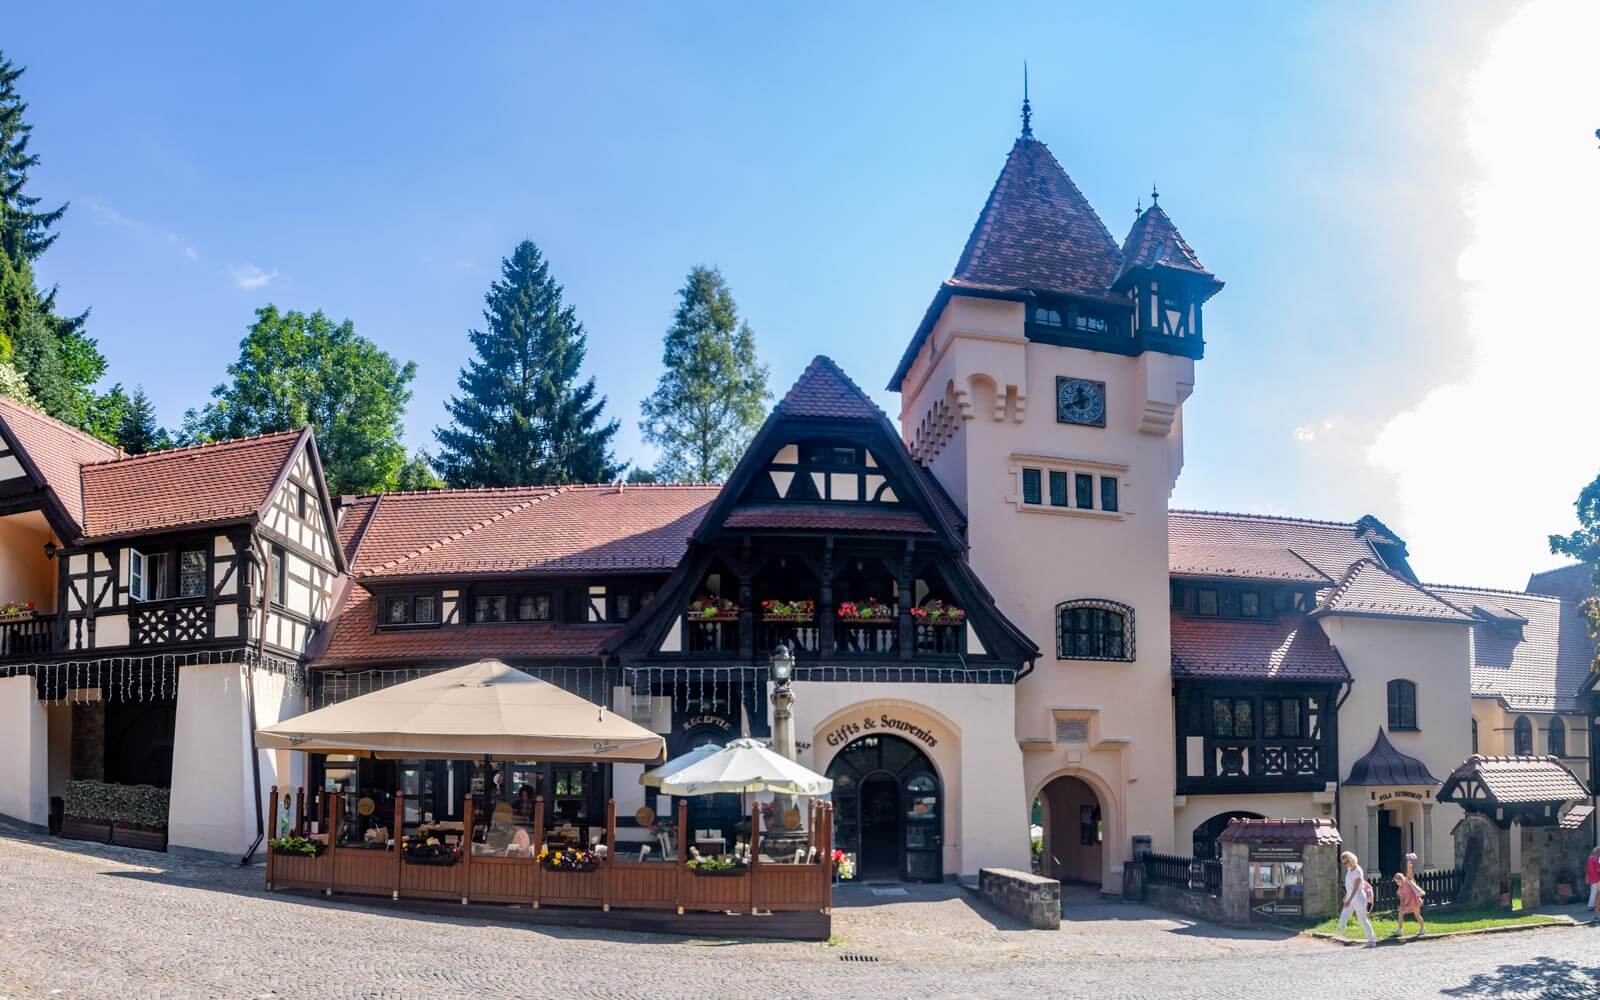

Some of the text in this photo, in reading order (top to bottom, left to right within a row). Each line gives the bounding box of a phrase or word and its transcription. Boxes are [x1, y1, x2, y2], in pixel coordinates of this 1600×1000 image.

[826, 722, 860, 747] Gifts
[863, 718, 876, 729] &
[881, 714, 938, 747] Souvenirs
